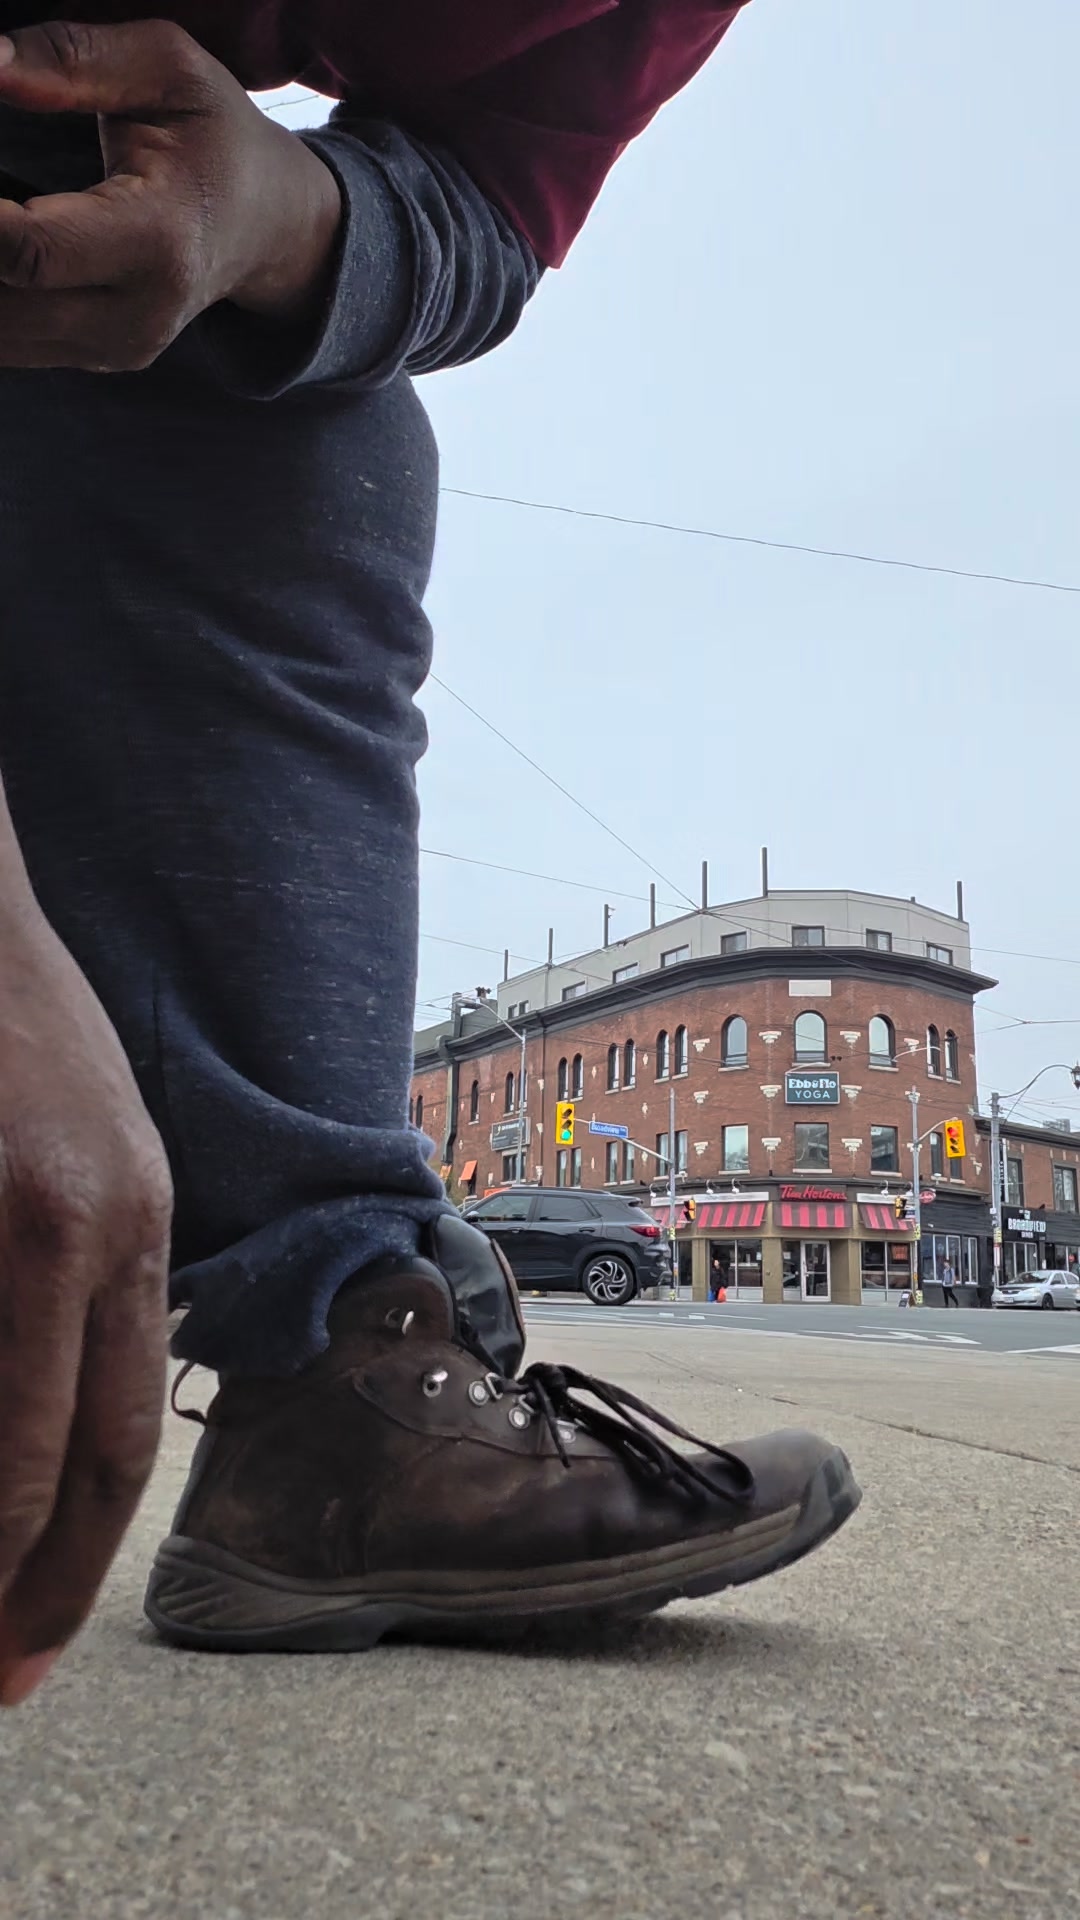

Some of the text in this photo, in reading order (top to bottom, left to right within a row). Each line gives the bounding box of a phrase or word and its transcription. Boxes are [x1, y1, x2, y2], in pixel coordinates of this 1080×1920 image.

[795, 1090, 830, 1099] YOGA
[780, 1184, 847, 1200] Tim Hortons
